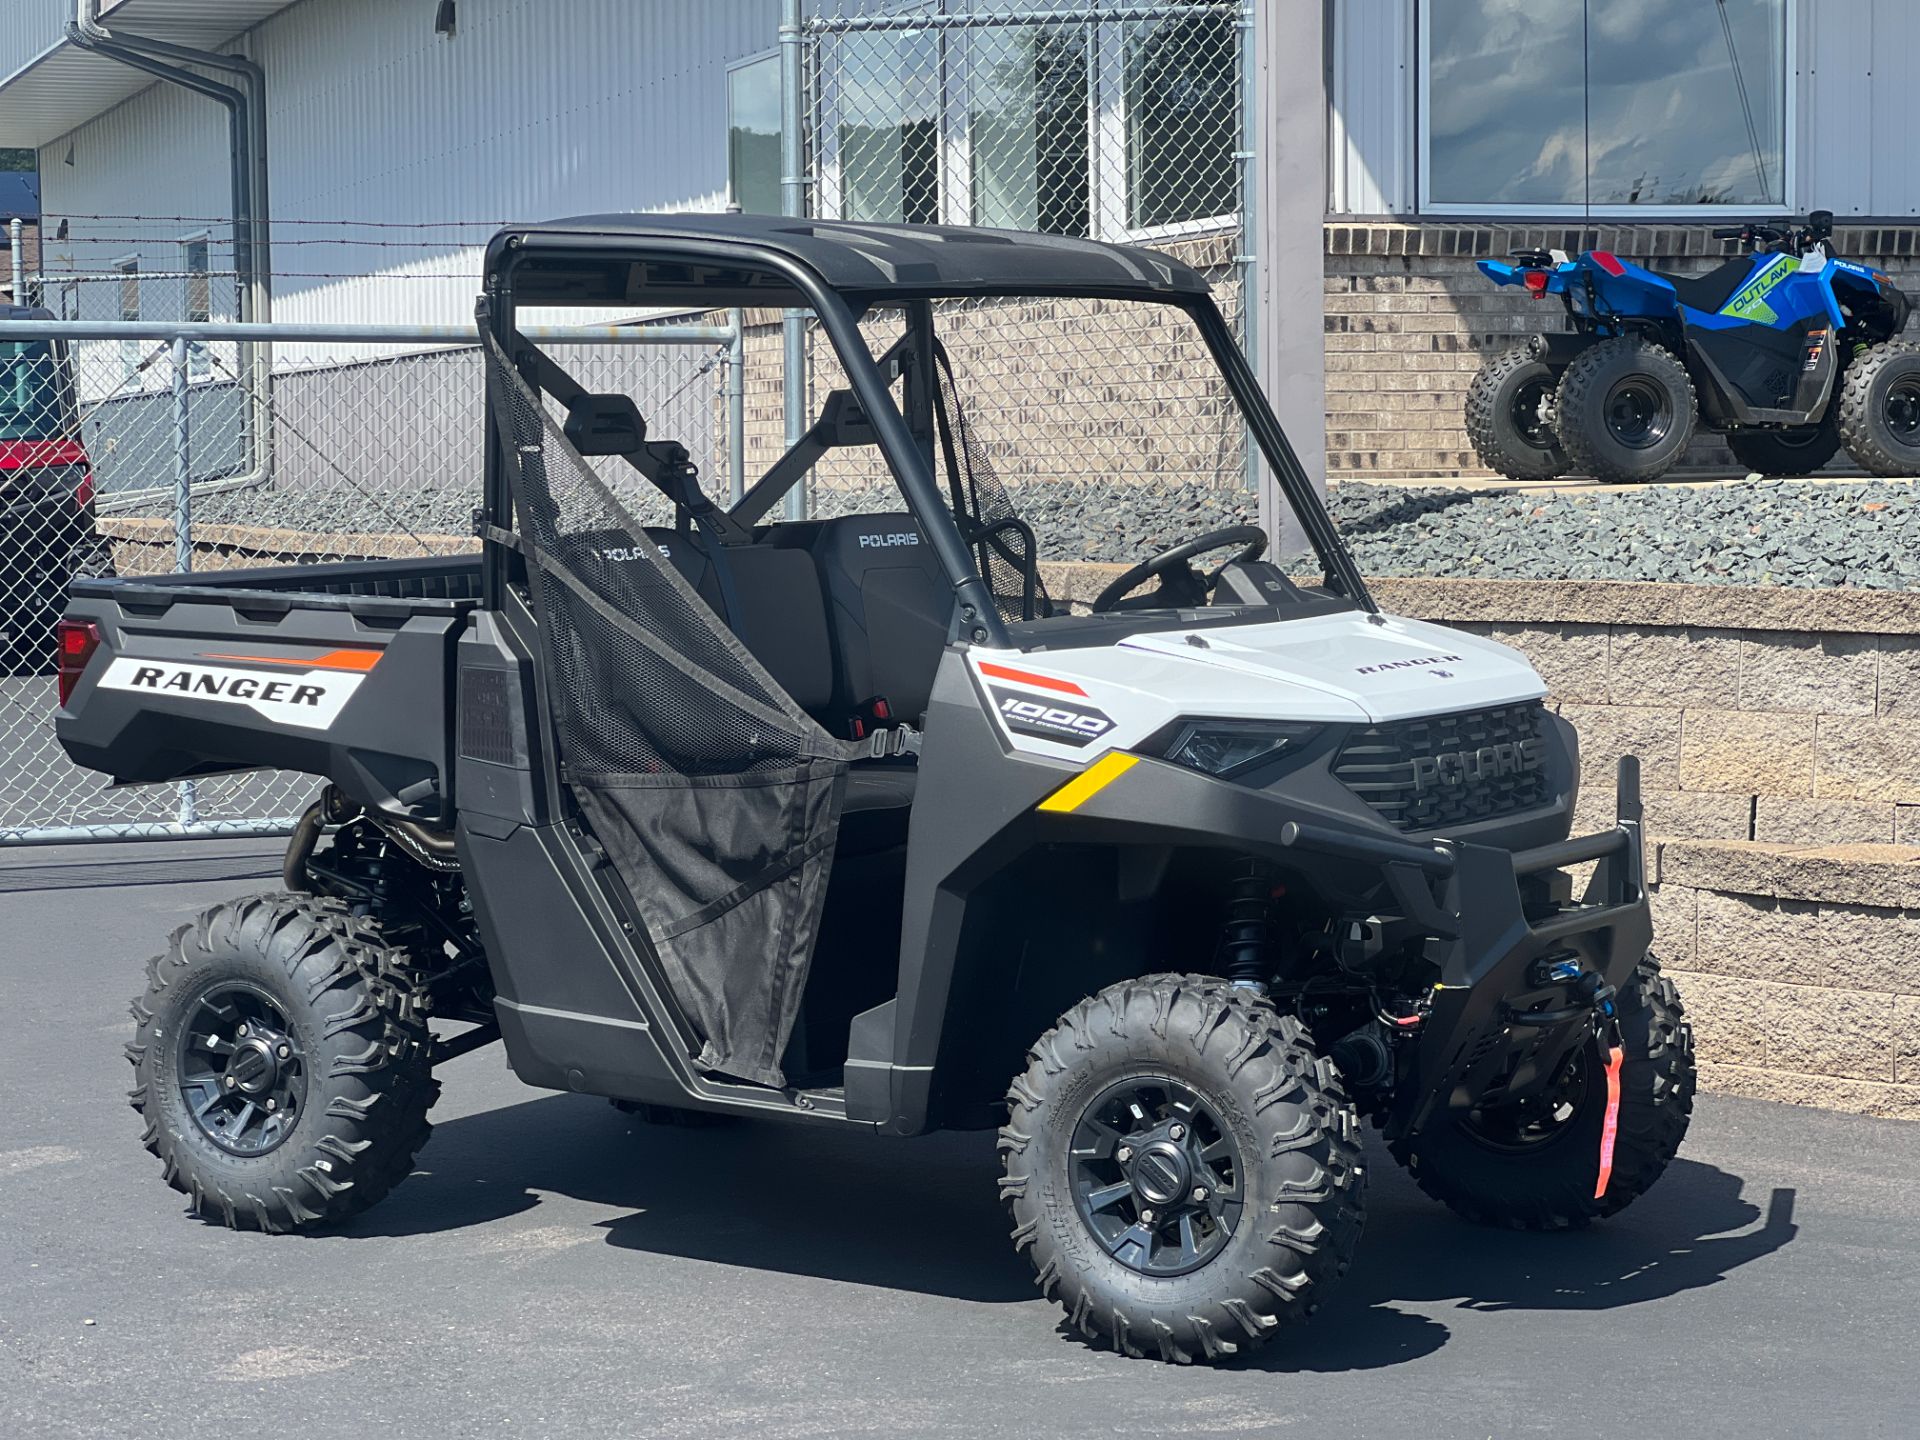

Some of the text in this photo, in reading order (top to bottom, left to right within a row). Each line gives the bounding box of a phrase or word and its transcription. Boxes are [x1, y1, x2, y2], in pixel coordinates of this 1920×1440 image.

[1833, 260, 1865, 273] POLARIS
[1733, 262, 1787, 312] OUTLAW
[858, 532, 919, 548] POLARIS
[1355, 655, 1463, 675] RANGER
[130, 666, 327, 707] RANGER
[1000, 698, 1109, 732] 1000
[1410, 739, 1545, 791] POLARIS
